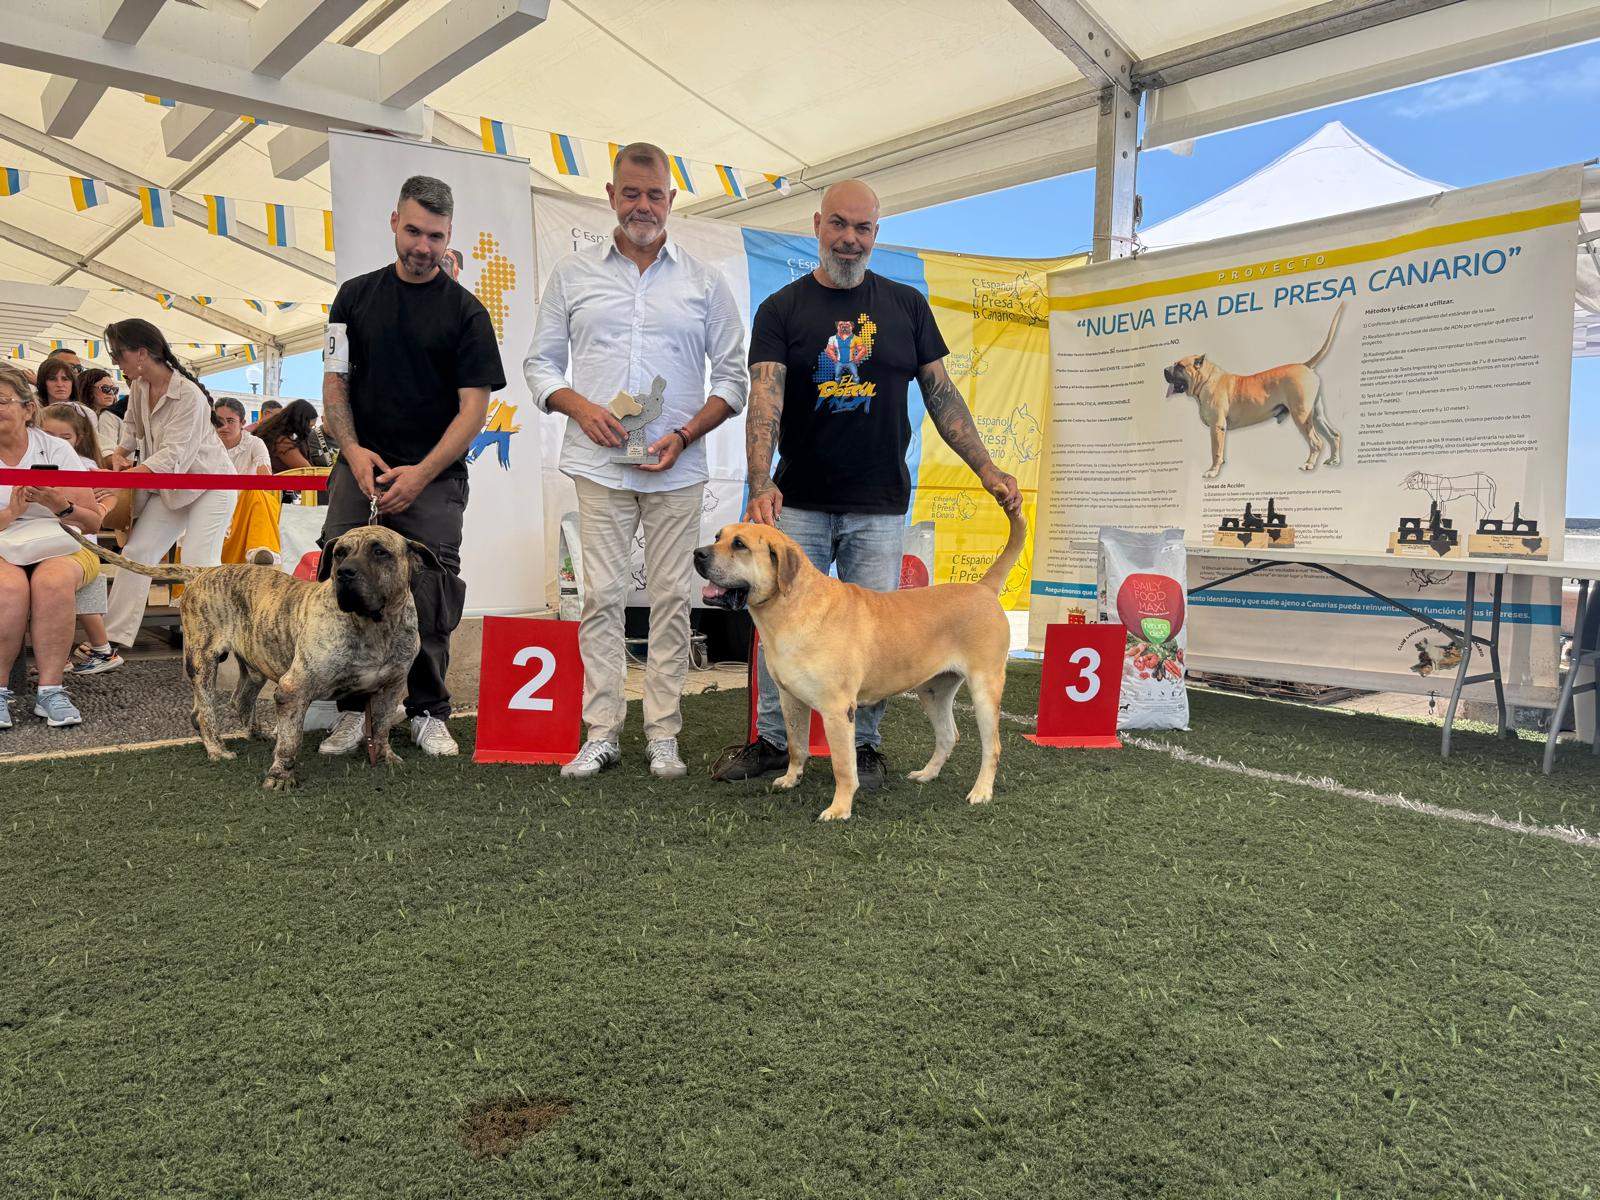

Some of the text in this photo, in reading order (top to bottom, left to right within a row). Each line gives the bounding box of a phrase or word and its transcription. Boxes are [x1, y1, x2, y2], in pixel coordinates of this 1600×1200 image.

[1217, 255, 1327, 281] PROYECTO
[982, 294, 1013, 309] Presa
[1165, 299, 1210, 325] ERA
[1217, 291, 1264, 317] DEL
[1273, 275, 1357, 309] PRESA
[982, 308, 1015, 322] Canario
[1365, 306, 1391, 315] Métodos
[1396, 303, 1424, 311] técnicas
[1450, 323, 1463, 331] ADN
[328, 336, 336, 355] 9
[977, 415, 1010, 428] Español
[961, 554, 994, 567] Español
[959, 570, 984, 582] Pres
[1133, 579, 1163, 592] DAILY
[1135, 590, 1168, 602] FOOD
[1138, 600, 1167, 613] MAXI
[1206, 594, 1241, 605] identitario
[1241, 599, 1247, 607] y
[1246, 599, 1260, 607] que
[1260, 598, 1280, 606] nadie
[1280, 600, 1300, 609] ajeno
[1306, 600, 1339, 610] Canarias
[1338, 602, 1361, 612] pueda
[1424, 605, 1456, 616] función
[508, 646, 556, 711] 2
[1065, 647, 1101, 703] 3
